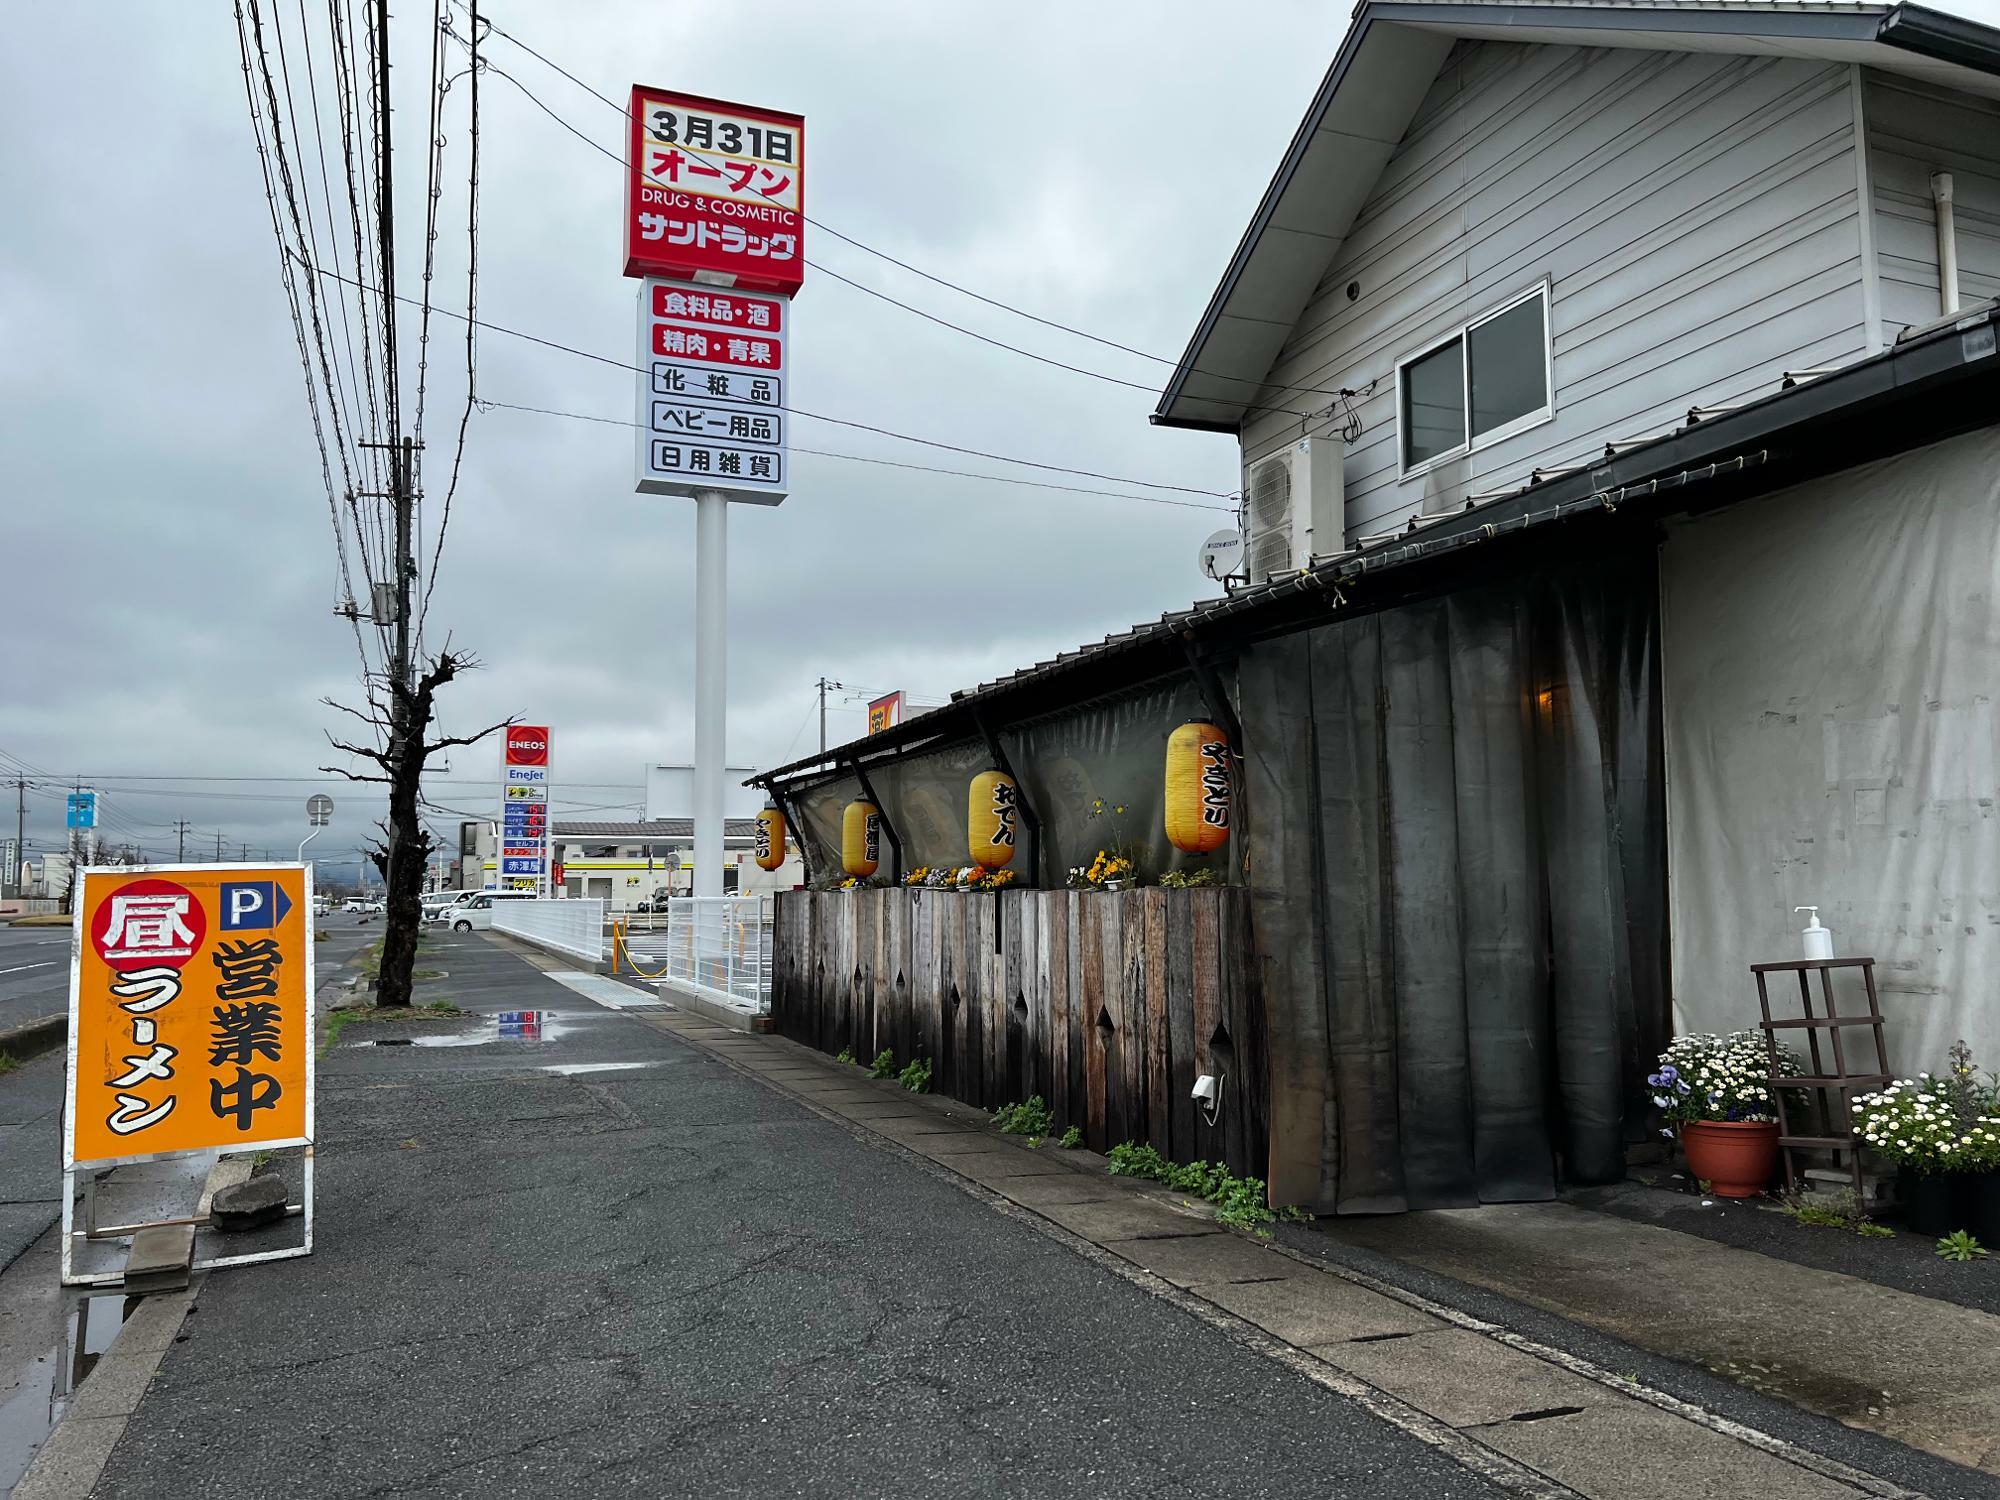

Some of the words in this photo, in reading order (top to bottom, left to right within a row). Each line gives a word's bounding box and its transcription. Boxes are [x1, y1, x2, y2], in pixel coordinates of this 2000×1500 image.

[652, 110, 793, 164] 3月31日
[651, 149, 791, 197] オープン
[641, 189, 690, 208] DRUG
[695, 197, 707, 212] &
[710, 200, 795, 226] COSMETIC
[638, 211, 797, 261] サンドラッグ
[664, 292, 770, 326] 食料品・酒
[663, 329, 771, 364] 精肉・青果
[662, 368, 771, 402] 化粧品
[662, 409, 771, 440] ベビー用品
[662, 446, 771, 478] 日用雑貨
[508, 740, 546, 750] ENEOS
[509, 770, 544, 781] EneJet
[528, 805, 545, 814] 157
[990, 781, 1016, 847] おでん
[231, 888, 264, 925] P
[209, 938, 283, 1131] 営業中
